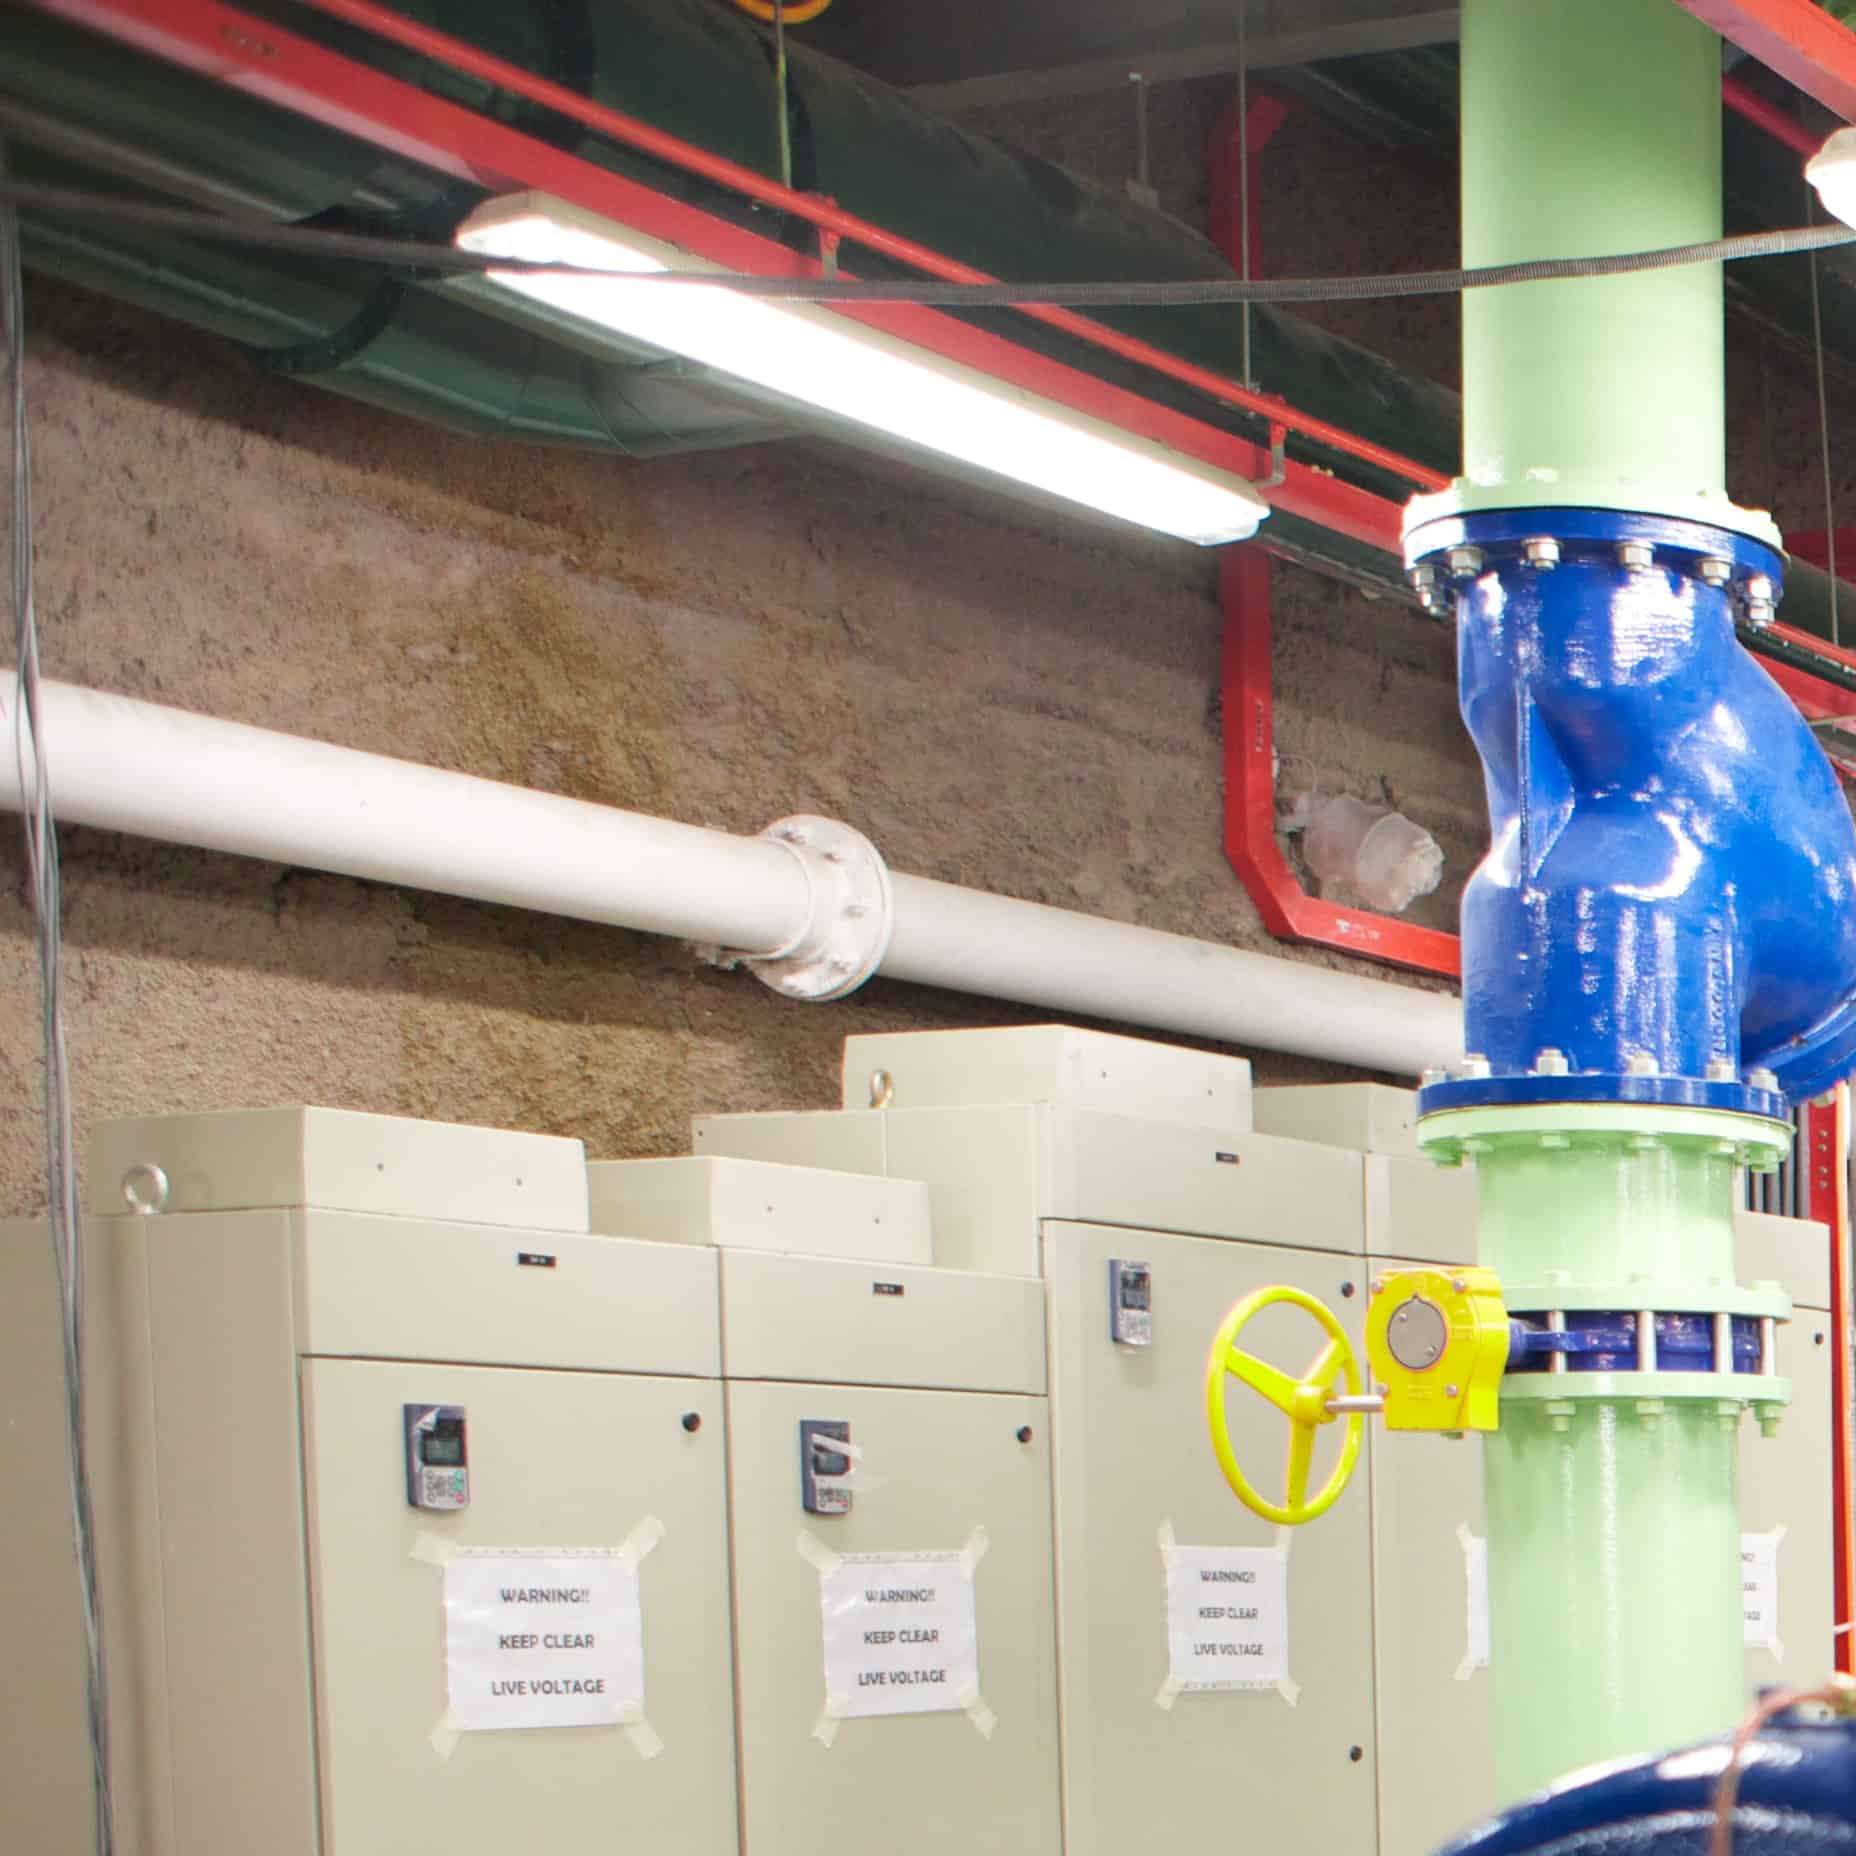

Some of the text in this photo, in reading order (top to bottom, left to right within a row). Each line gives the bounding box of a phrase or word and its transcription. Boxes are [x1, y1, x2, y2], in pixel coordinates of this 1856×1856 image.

[500, 1588, 590, 1604] WARNING!!
[865, 1589, 936, 1603] WARNING!!
[499, 1634, 595, 1650] KEEP CLEAR
[864, 1629, 940, 1644] KEEP CLEAR
[1193, 1643, 1264, 1656] LIVE VOLTAGE
[858, 1670, 947, 1686] LIVE VOLTAGE
[491, 1679, 606, 1696] LIVE VOLTAGE
